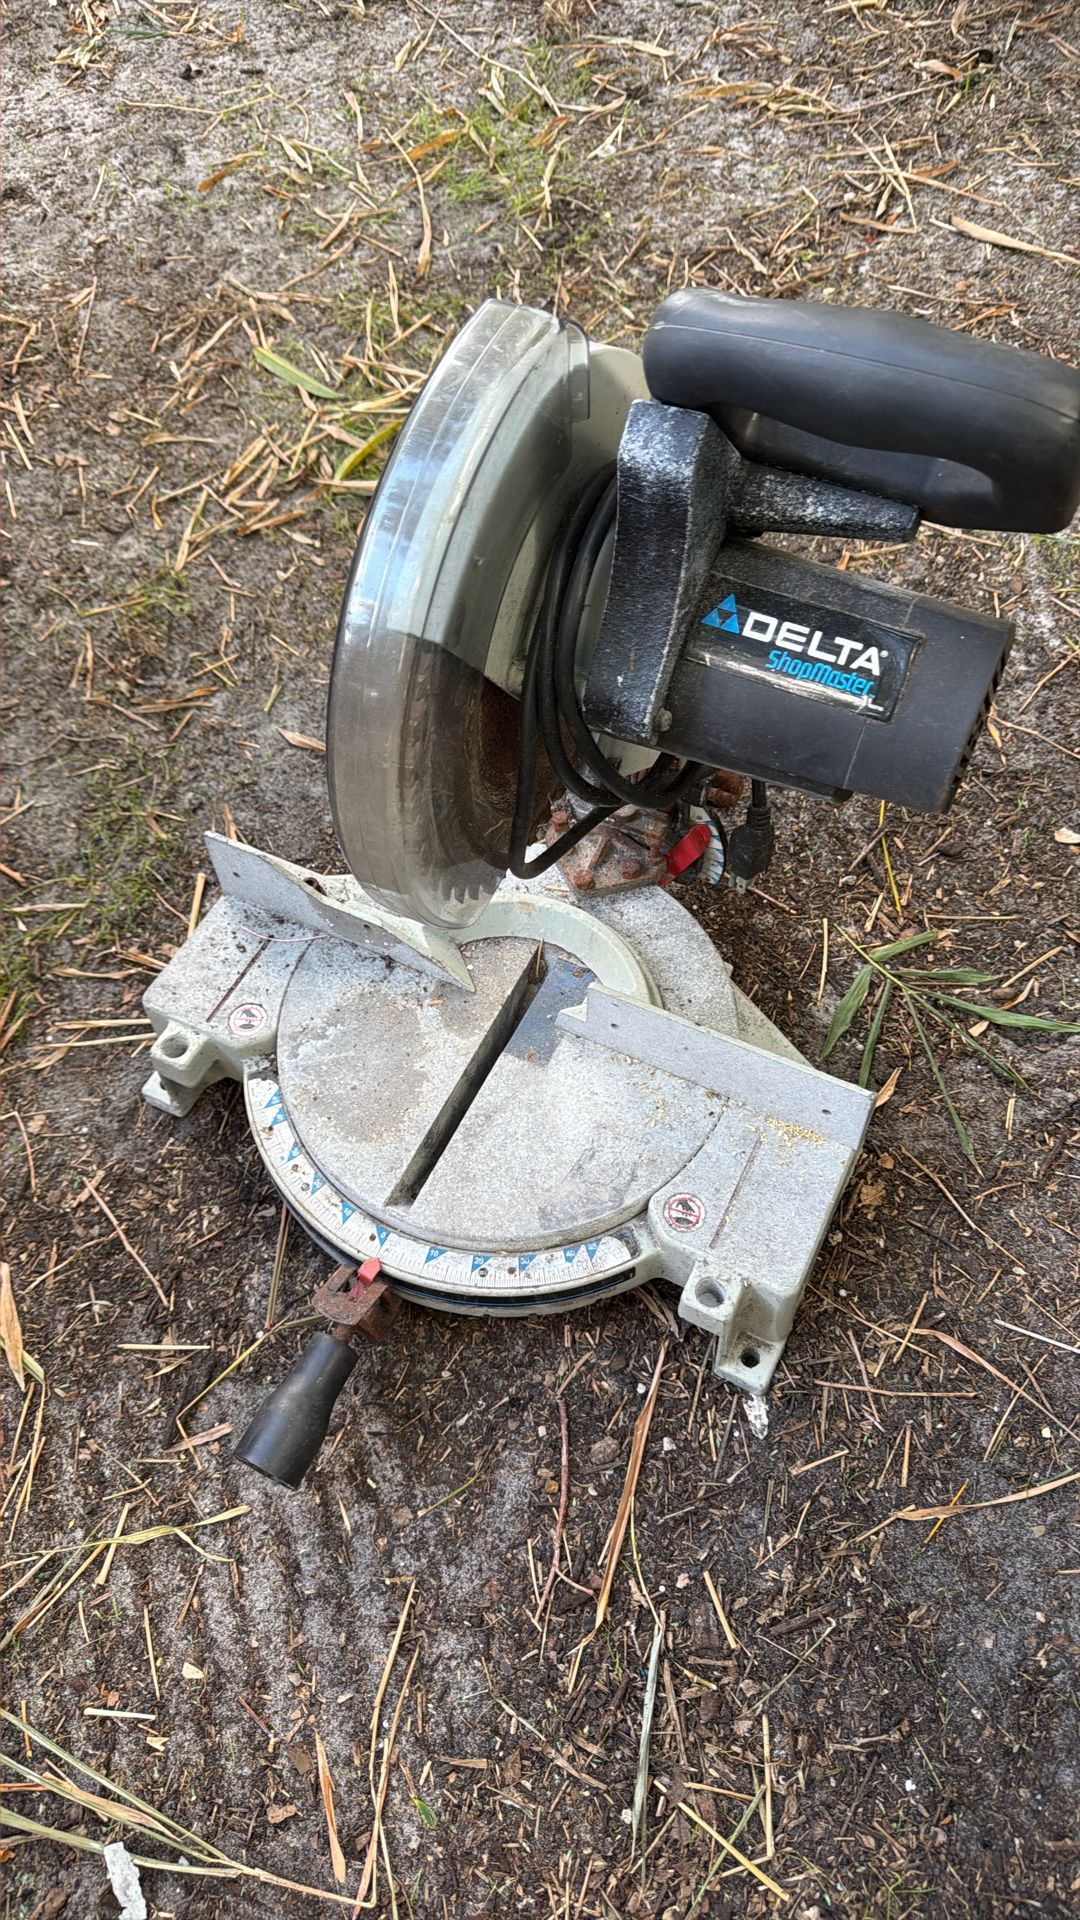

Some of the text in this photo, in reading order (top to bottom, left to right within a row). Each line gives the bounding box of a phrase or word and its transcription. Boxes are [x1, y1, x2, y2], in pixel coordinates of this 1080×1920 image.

[742, 611, 881, 676] DELTA
[765, 649, 875, 697] ShopMaster
[343, 1206, 353, 1217] 10
[430, 1248, 440, 1257] 10
[474, 1256, 485, 1265] 20
